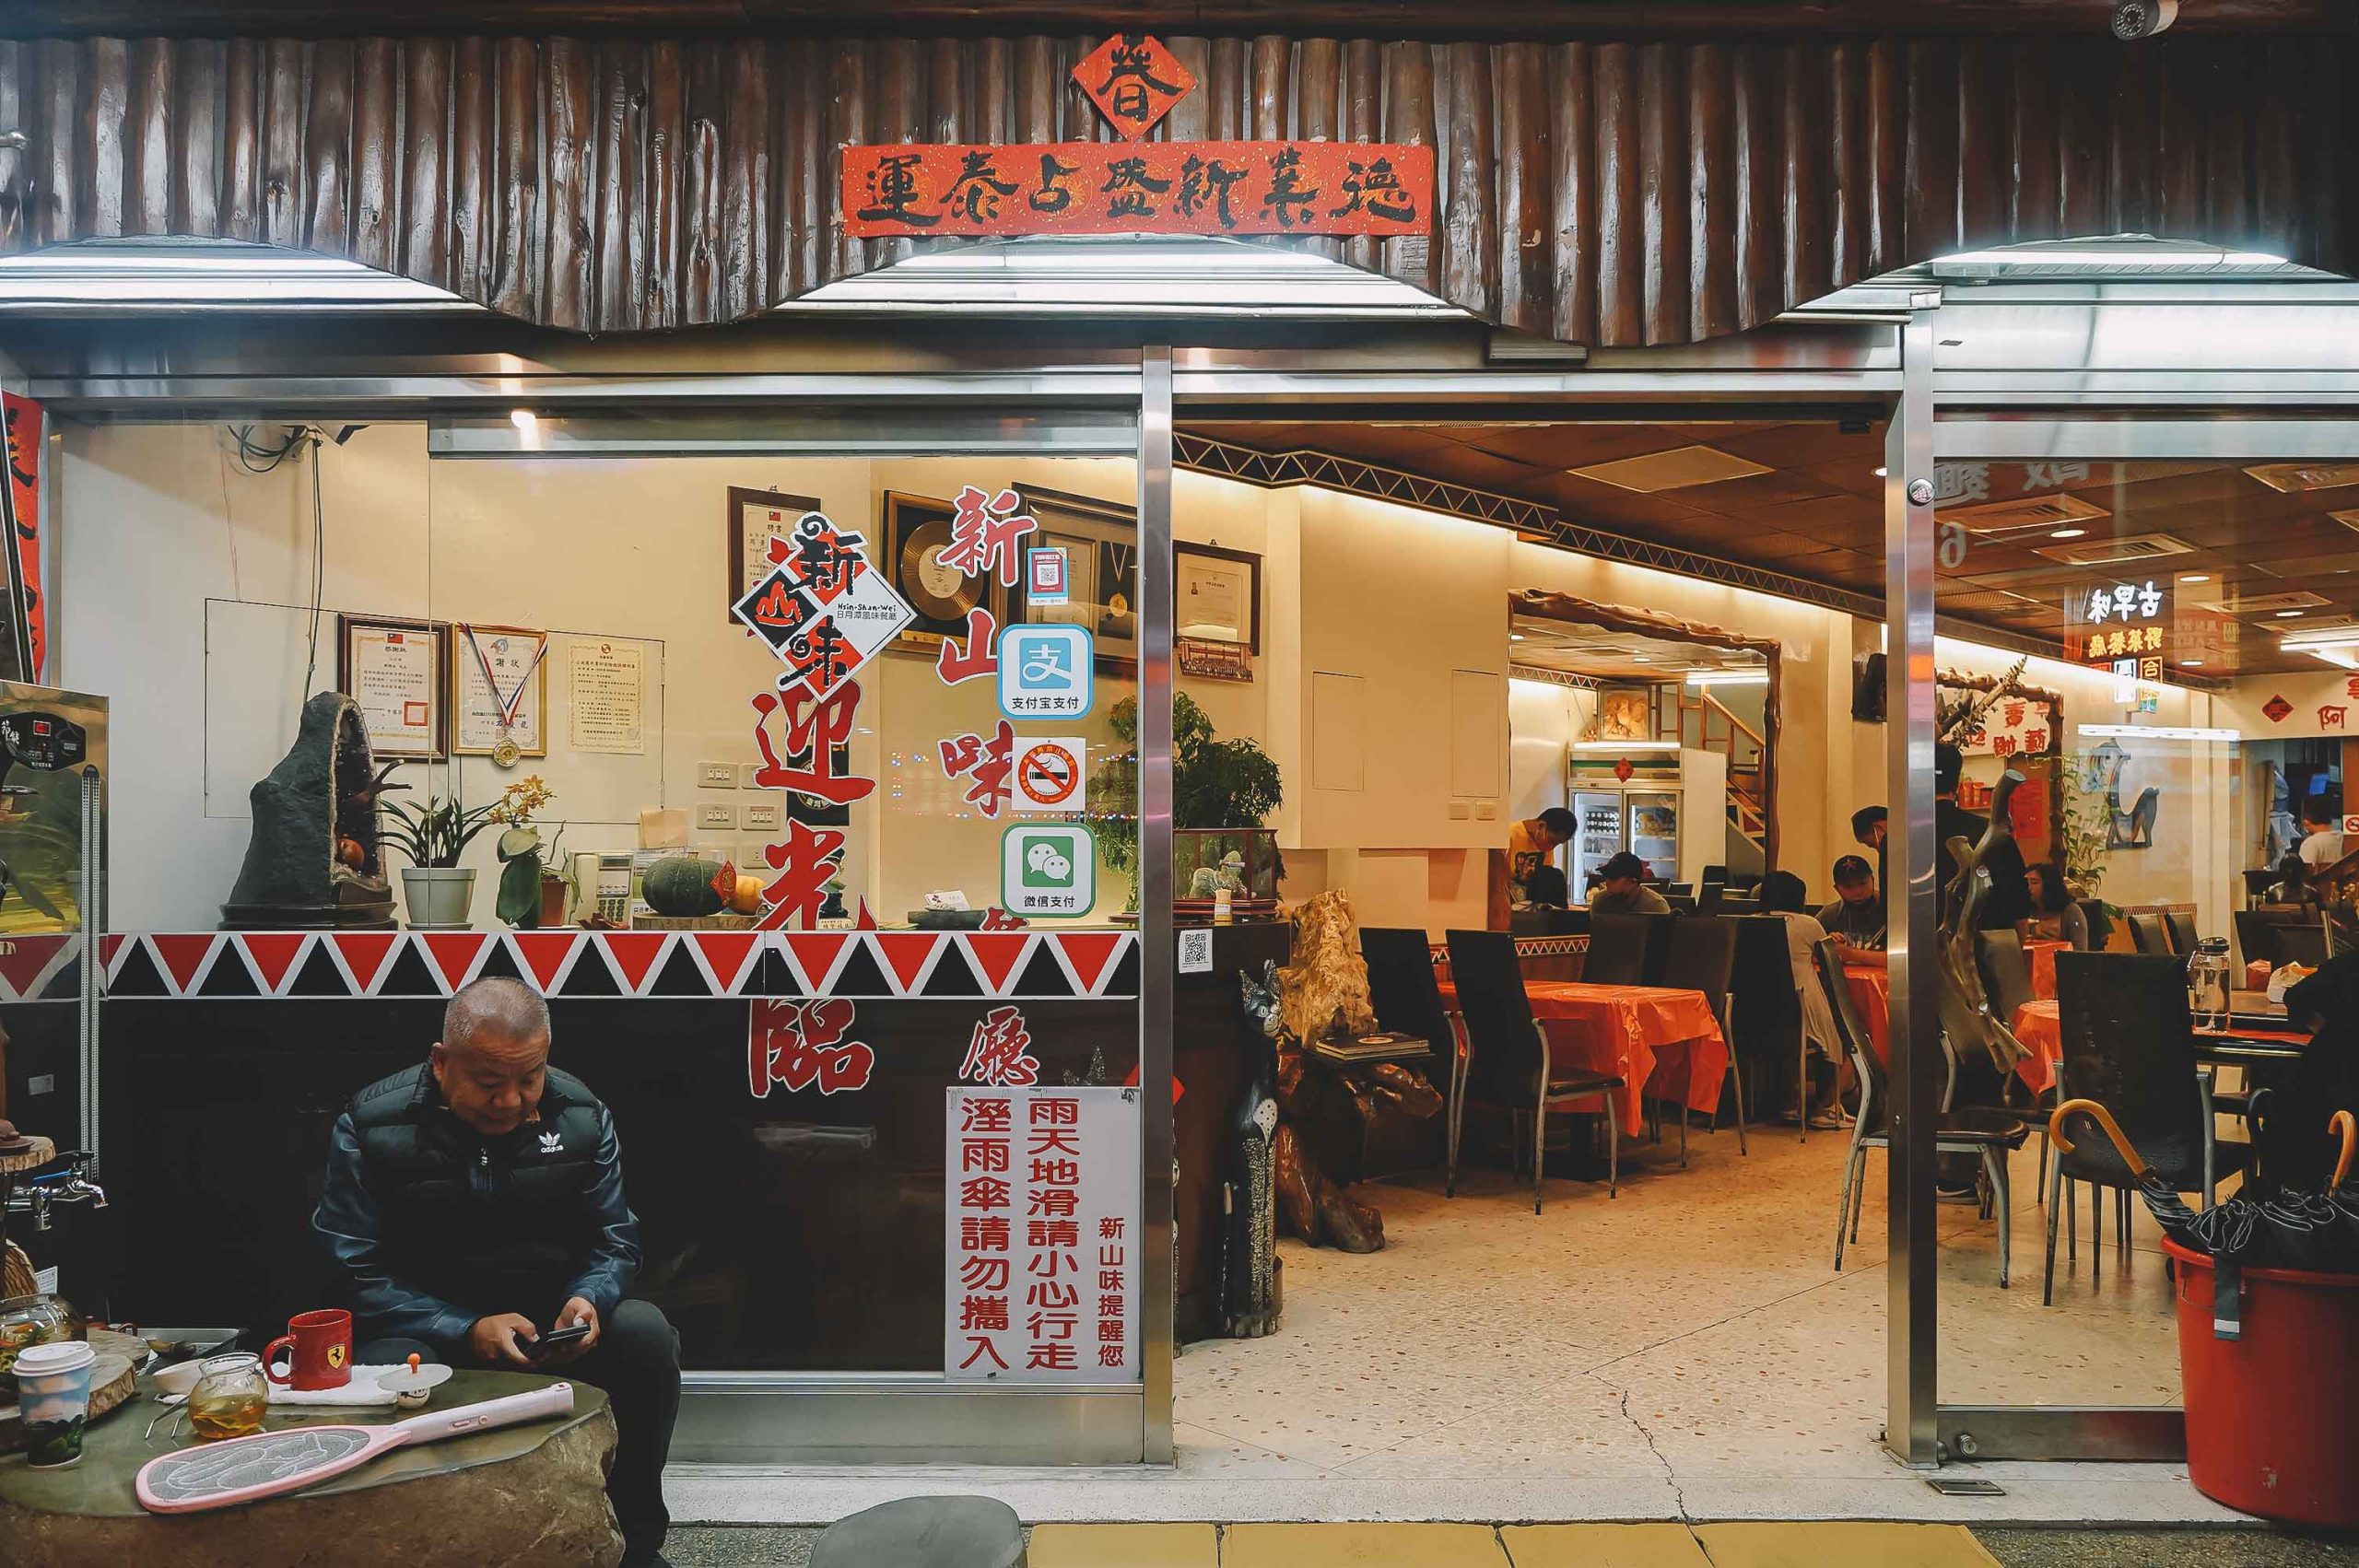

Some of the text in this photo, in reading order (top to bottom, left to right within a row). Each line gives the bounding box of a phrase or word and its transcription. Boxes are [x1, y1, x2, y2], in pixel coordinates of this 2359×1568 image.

[1097, 47, 1182, 123] 春
[837, 603, 897, 612] Hsin-Shan-Wei
[1012, 696, 1079, 708] 支付宝支付
[1024, 895, 1075, 907] 微信支付
[1027, 1097, 1081, 1370] 雨天地滑請小心行走
[1098, 1216, 1125, 1367] 新山味提醒您
